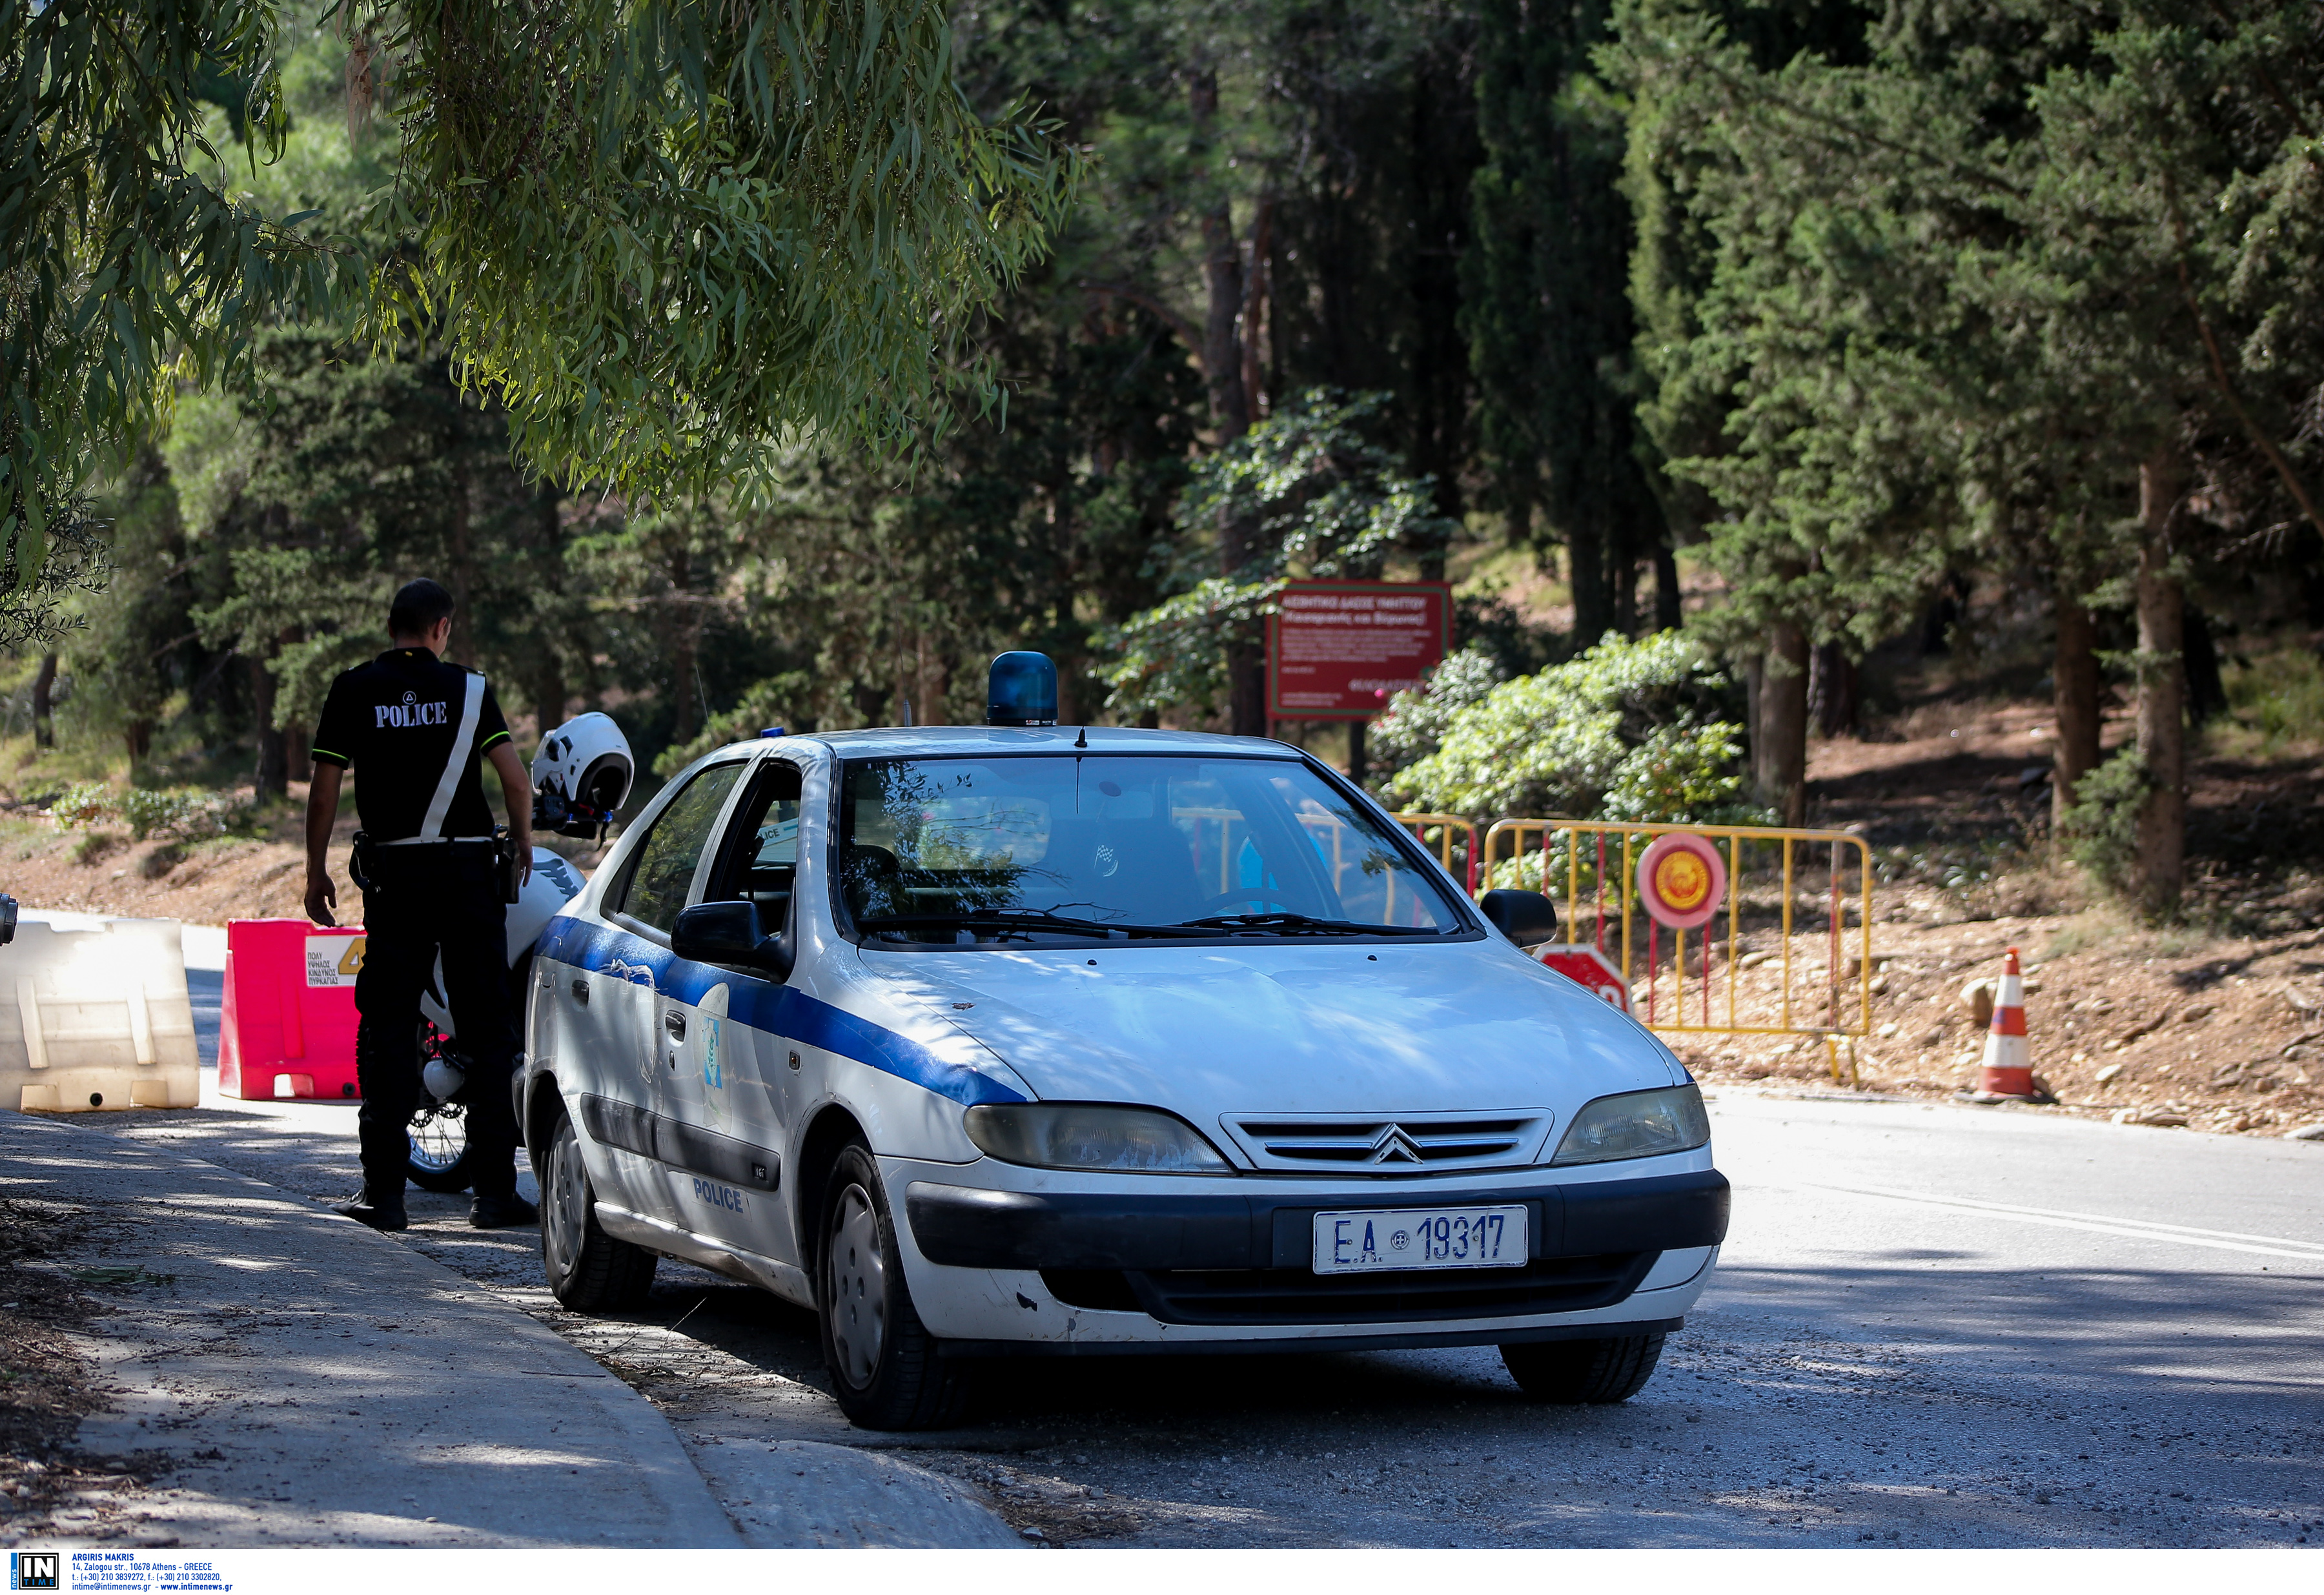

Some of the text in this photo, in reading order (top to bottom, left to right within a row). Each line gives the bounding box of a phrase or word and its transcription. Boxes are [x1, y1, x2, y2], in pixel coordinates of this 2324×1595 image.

[374, 702, 447, 727] POLICE
[307, 960, 330, 968] ΥΨΗΛΟΣ
[309, 977, 338, 986] ΠΥΡΚΑΓΙΑΣ
[693, 1178, 744, 1214] POLICE
[1417, 1214, 1504, 1261] 19317
